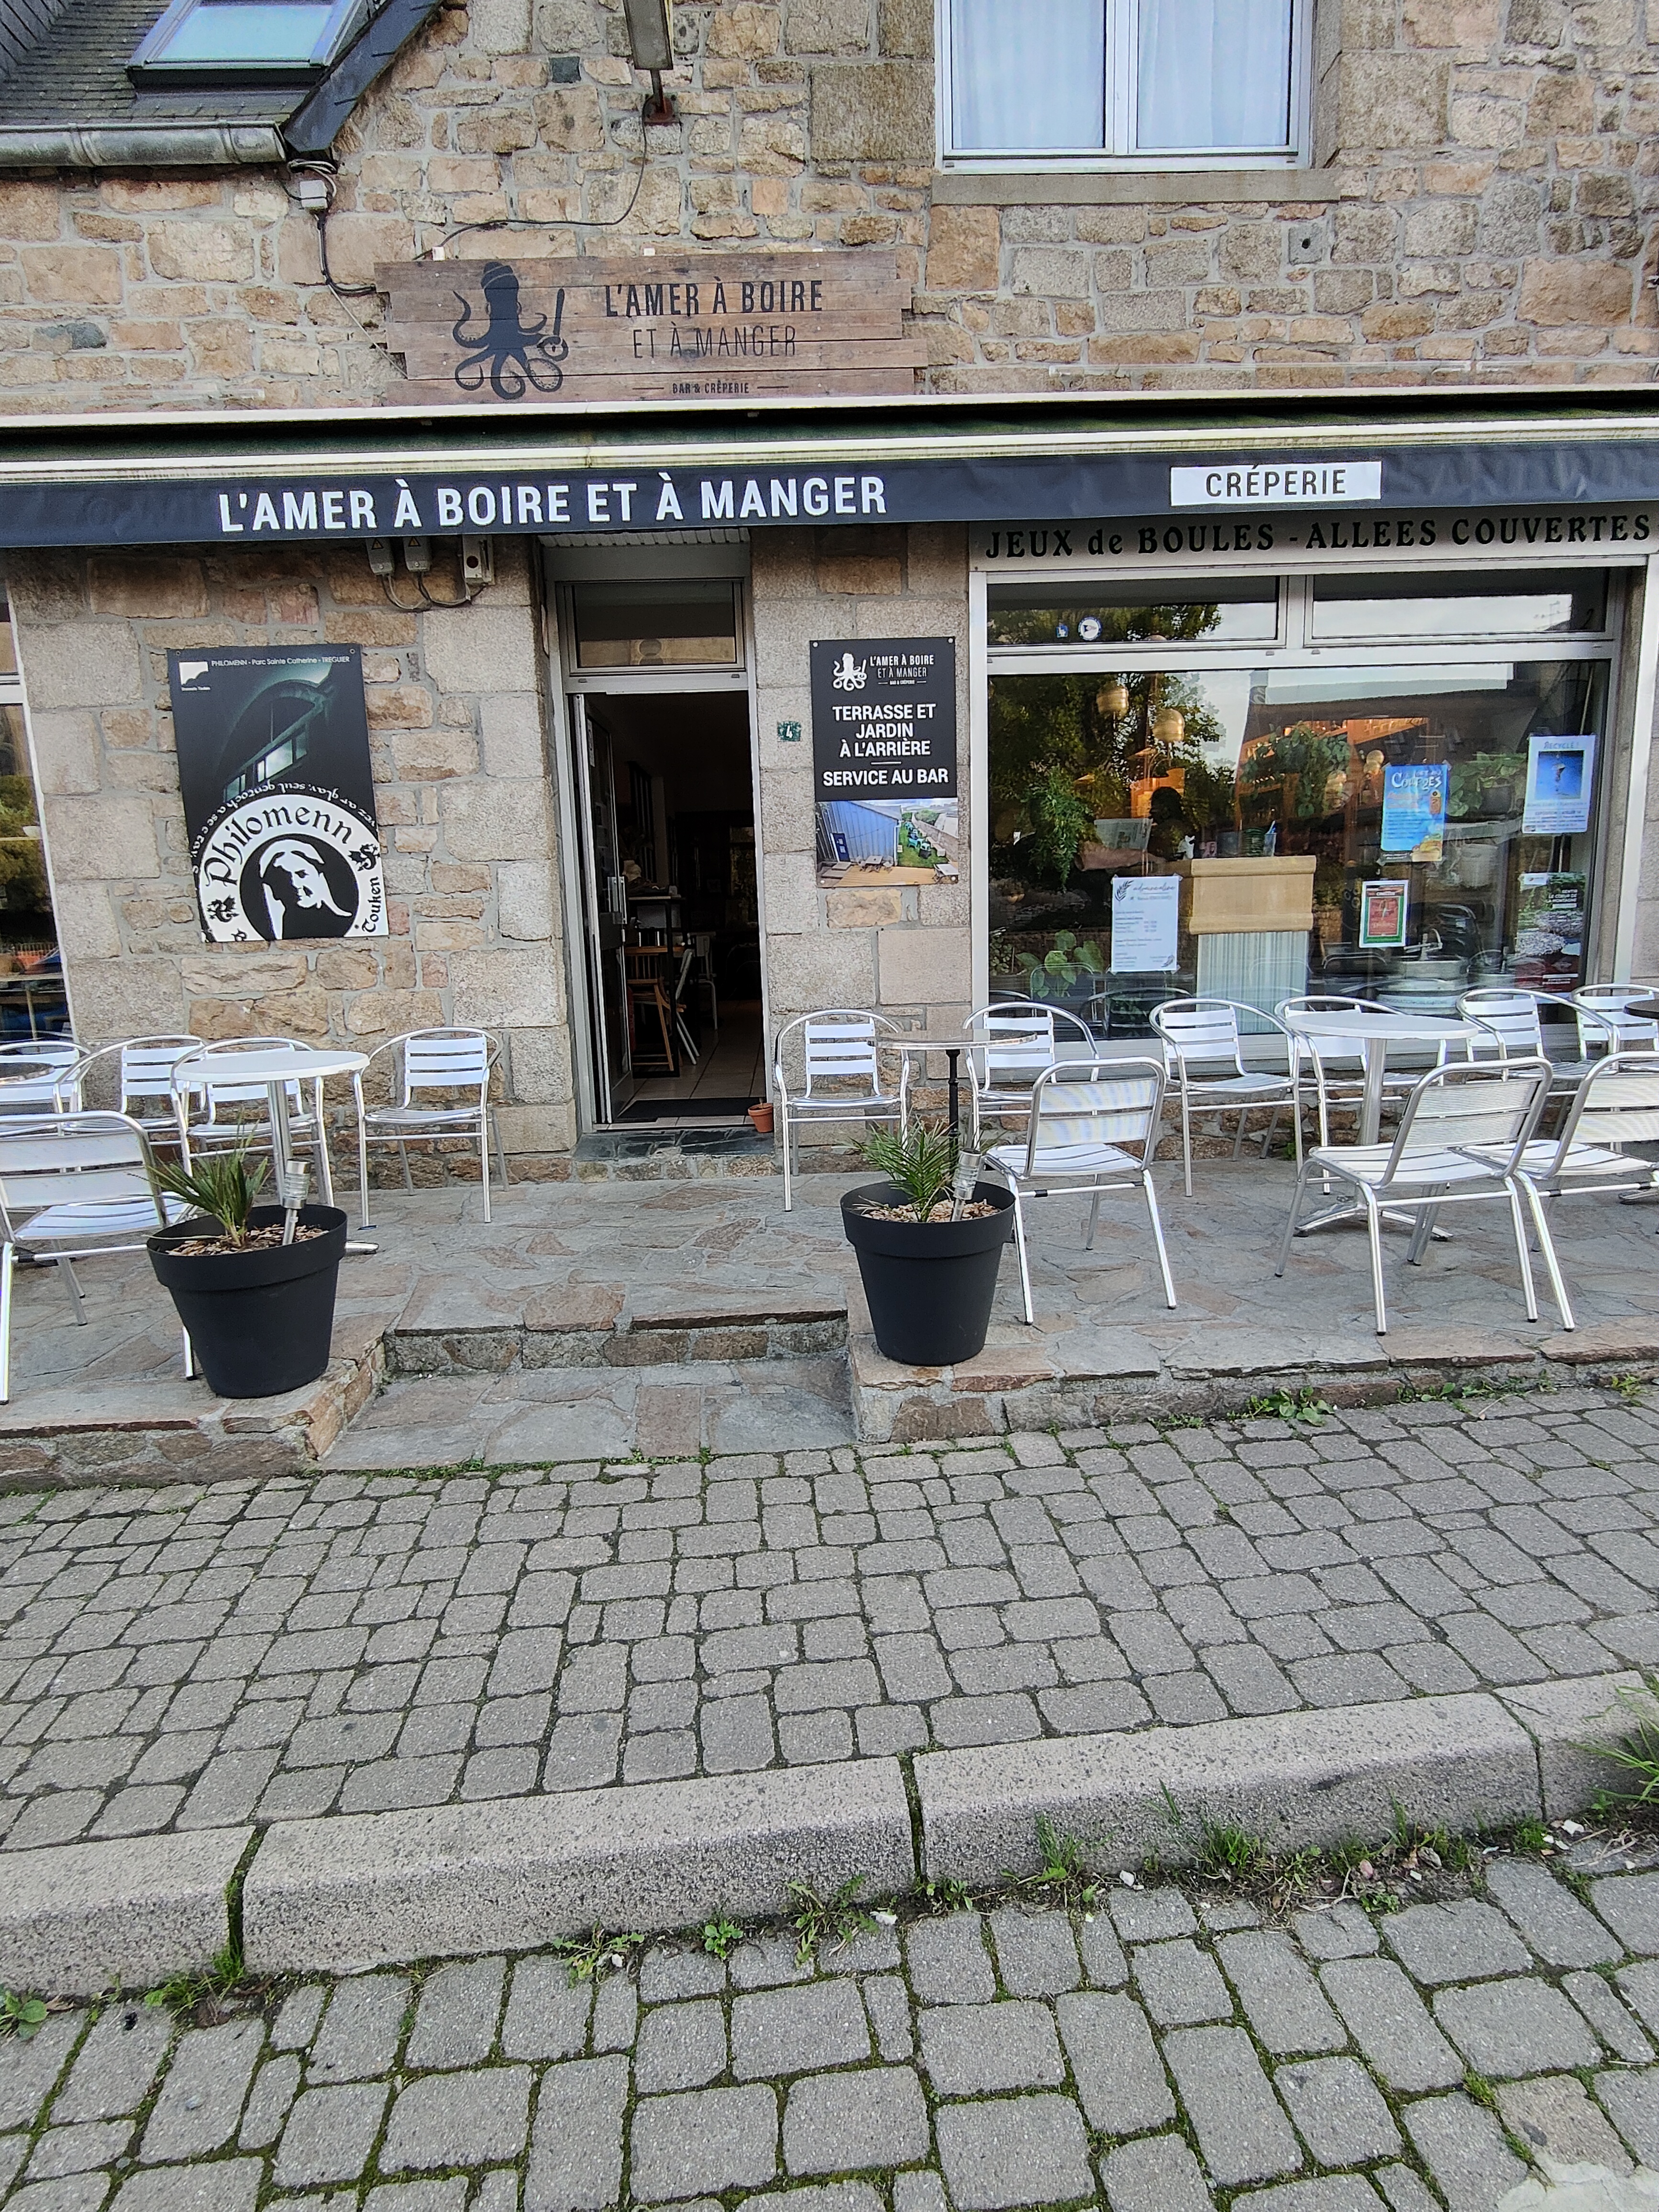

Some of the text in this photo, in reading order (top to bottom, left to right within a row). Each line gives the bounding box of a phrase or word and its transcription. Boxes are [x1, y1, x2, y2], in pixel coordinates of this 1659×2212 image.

[605, 276, 823, 317] L'AMER À BOIRE
[633, 321, 796, 359] ET À MANGER
[672, 380, 750, 394] BAR & CRÊPERIE
[1206, 463, 1346, 498] CRÉPERIE
[219, 471, 887, 532] L'AMER À BOIRE ET À MANGER
[985, 529, 1073, 559] JEUX
[1087, 529, 1123, 556] de
[1138, 522, 1274, 554] BOULES
[1305, 519, 1437, 550] ALLEES
[1451, 513, 1651, 545] COUVERTES
[870, 653, 934, 666] L'AMER À BOIRE
[877, 666, 928, 678] ET À MANGER
[831, 703, 937, 721] TERRASSE ET
[785, 724, 793, 739] 4
[855, 722, 914, 739] JARDIN
[839, 737, 931, 758] À L'ARRIÈRE
[822, 768, 949, 786] SERVICE AU BAR
[204, 806, 352, 886] Philomenn
[361, 876, 382, 933] Touken
